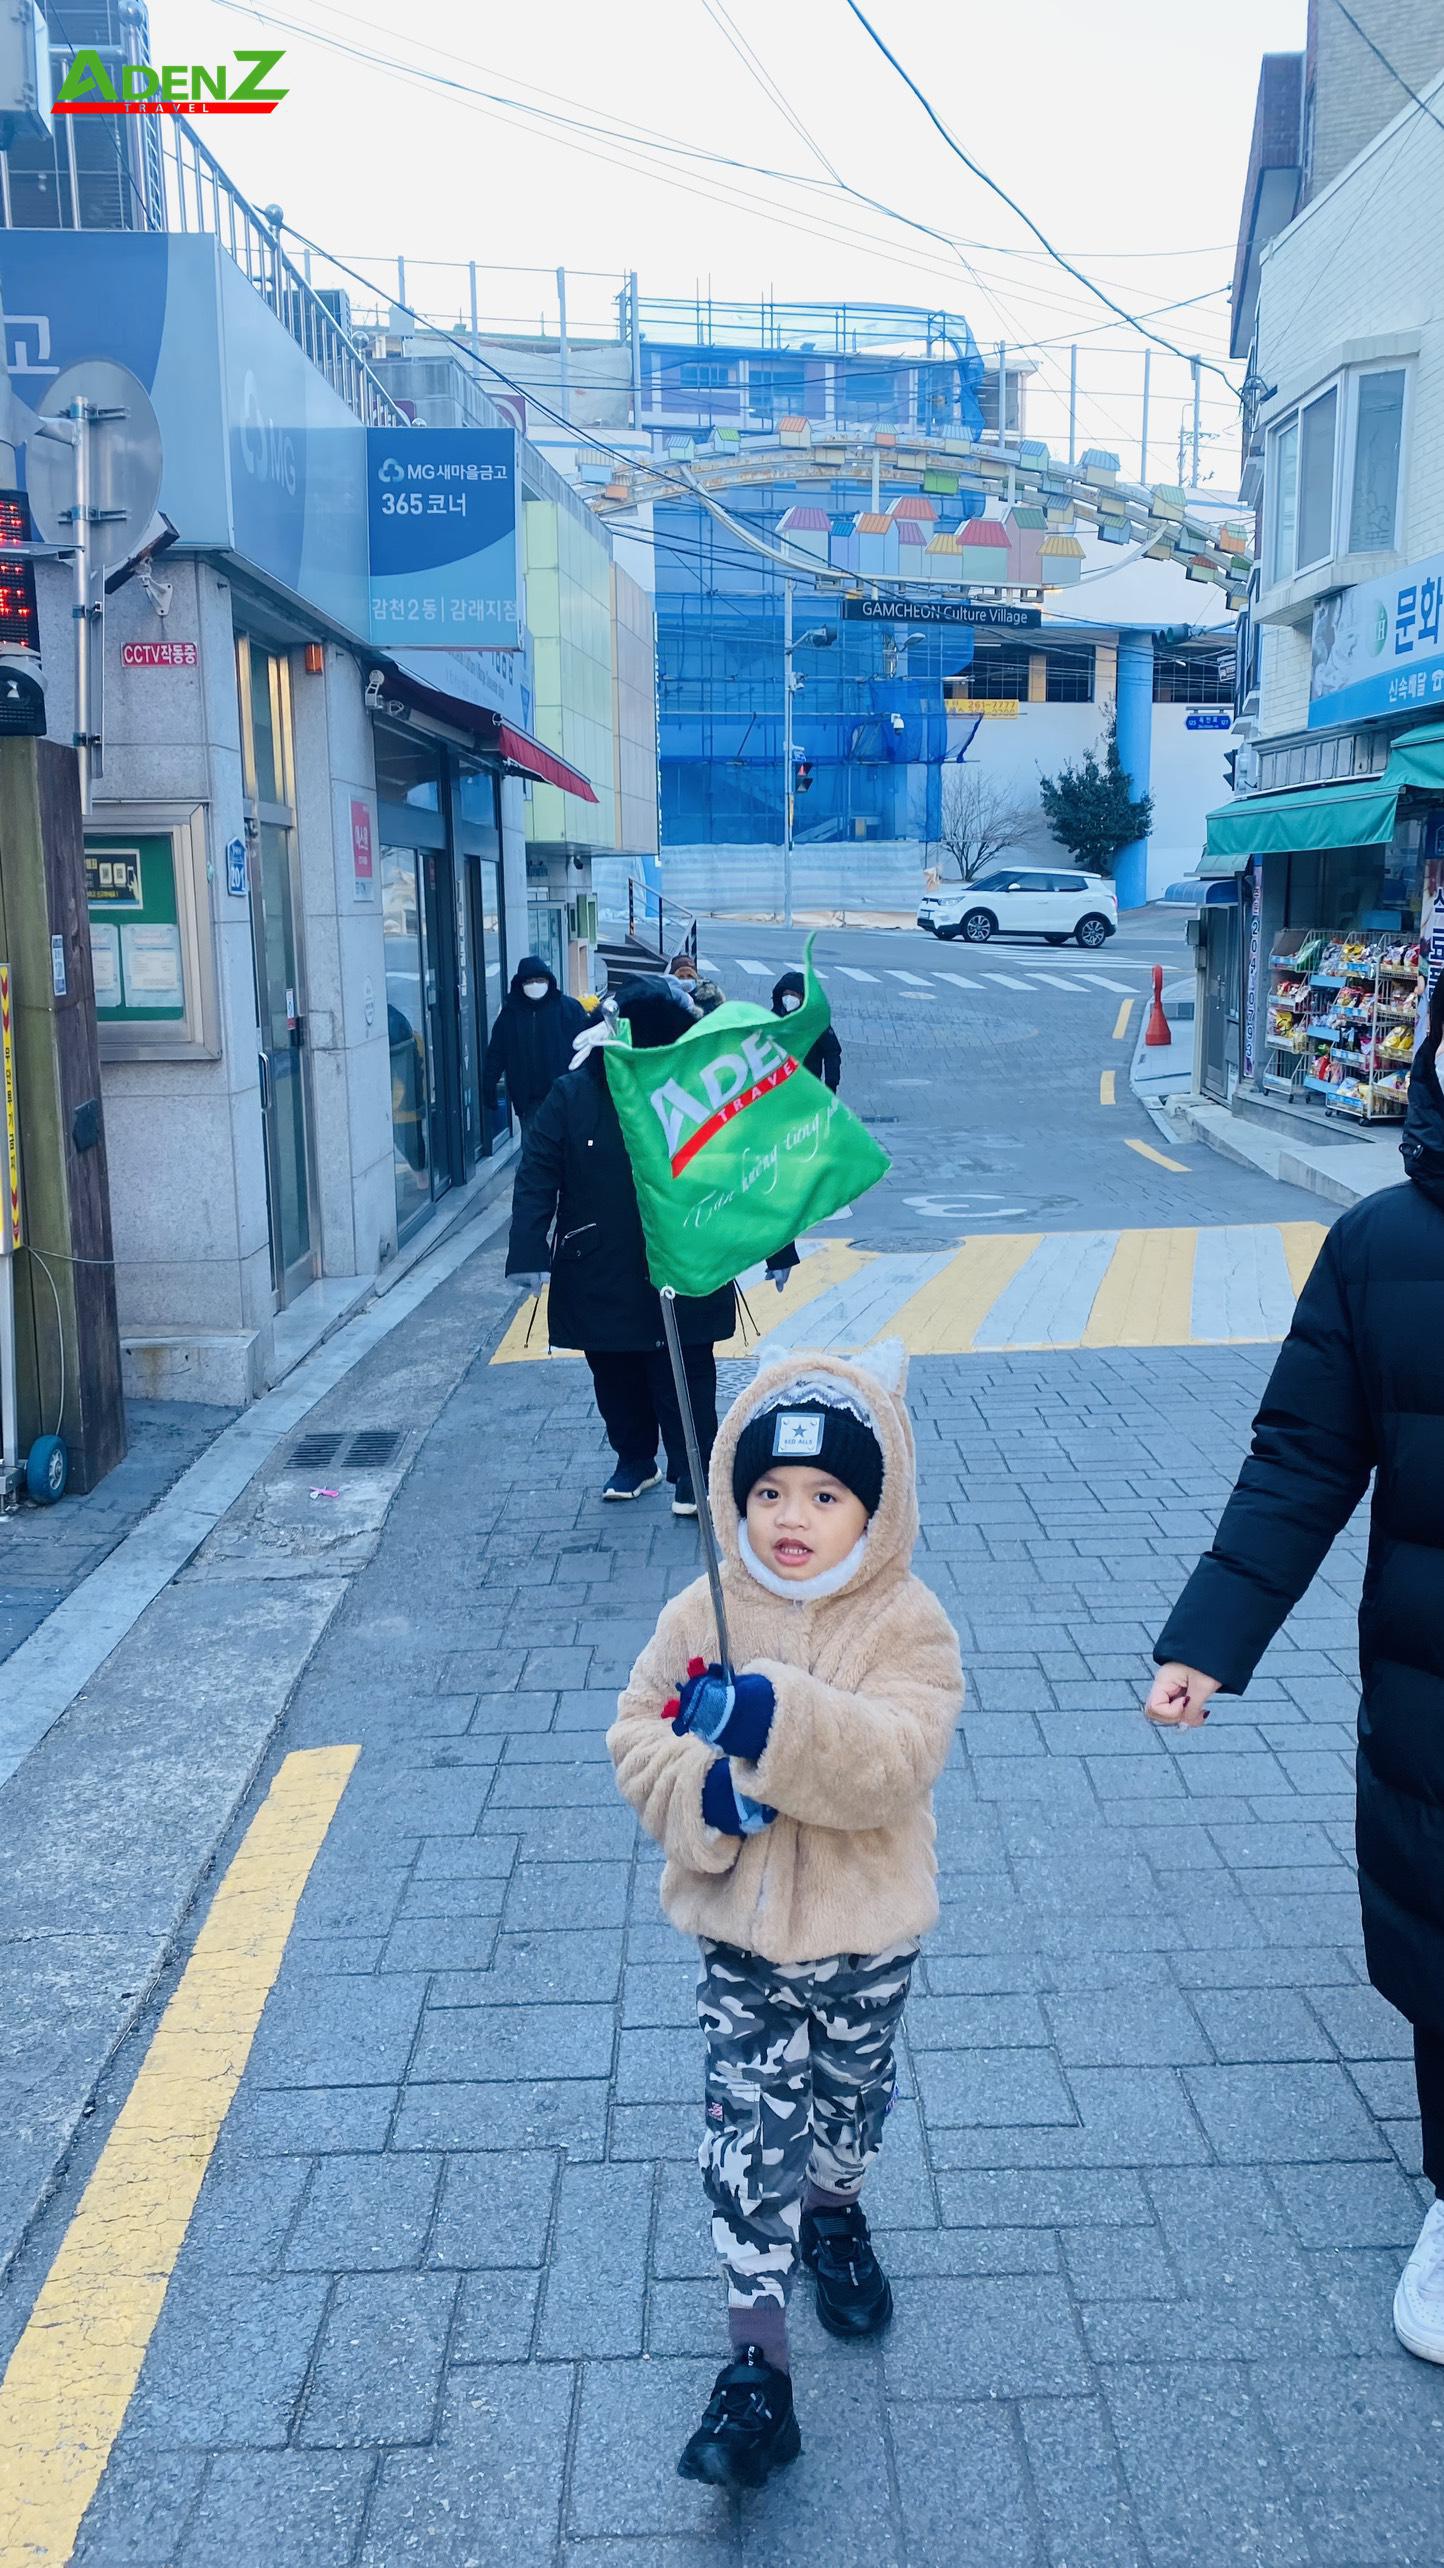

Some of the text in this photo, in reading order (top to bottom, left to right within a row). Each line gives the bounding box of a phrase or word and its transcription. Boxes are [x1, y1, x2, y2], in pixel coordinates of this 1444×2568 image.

[862, 601, 1028, 626] GAMCHEON Culture Village
